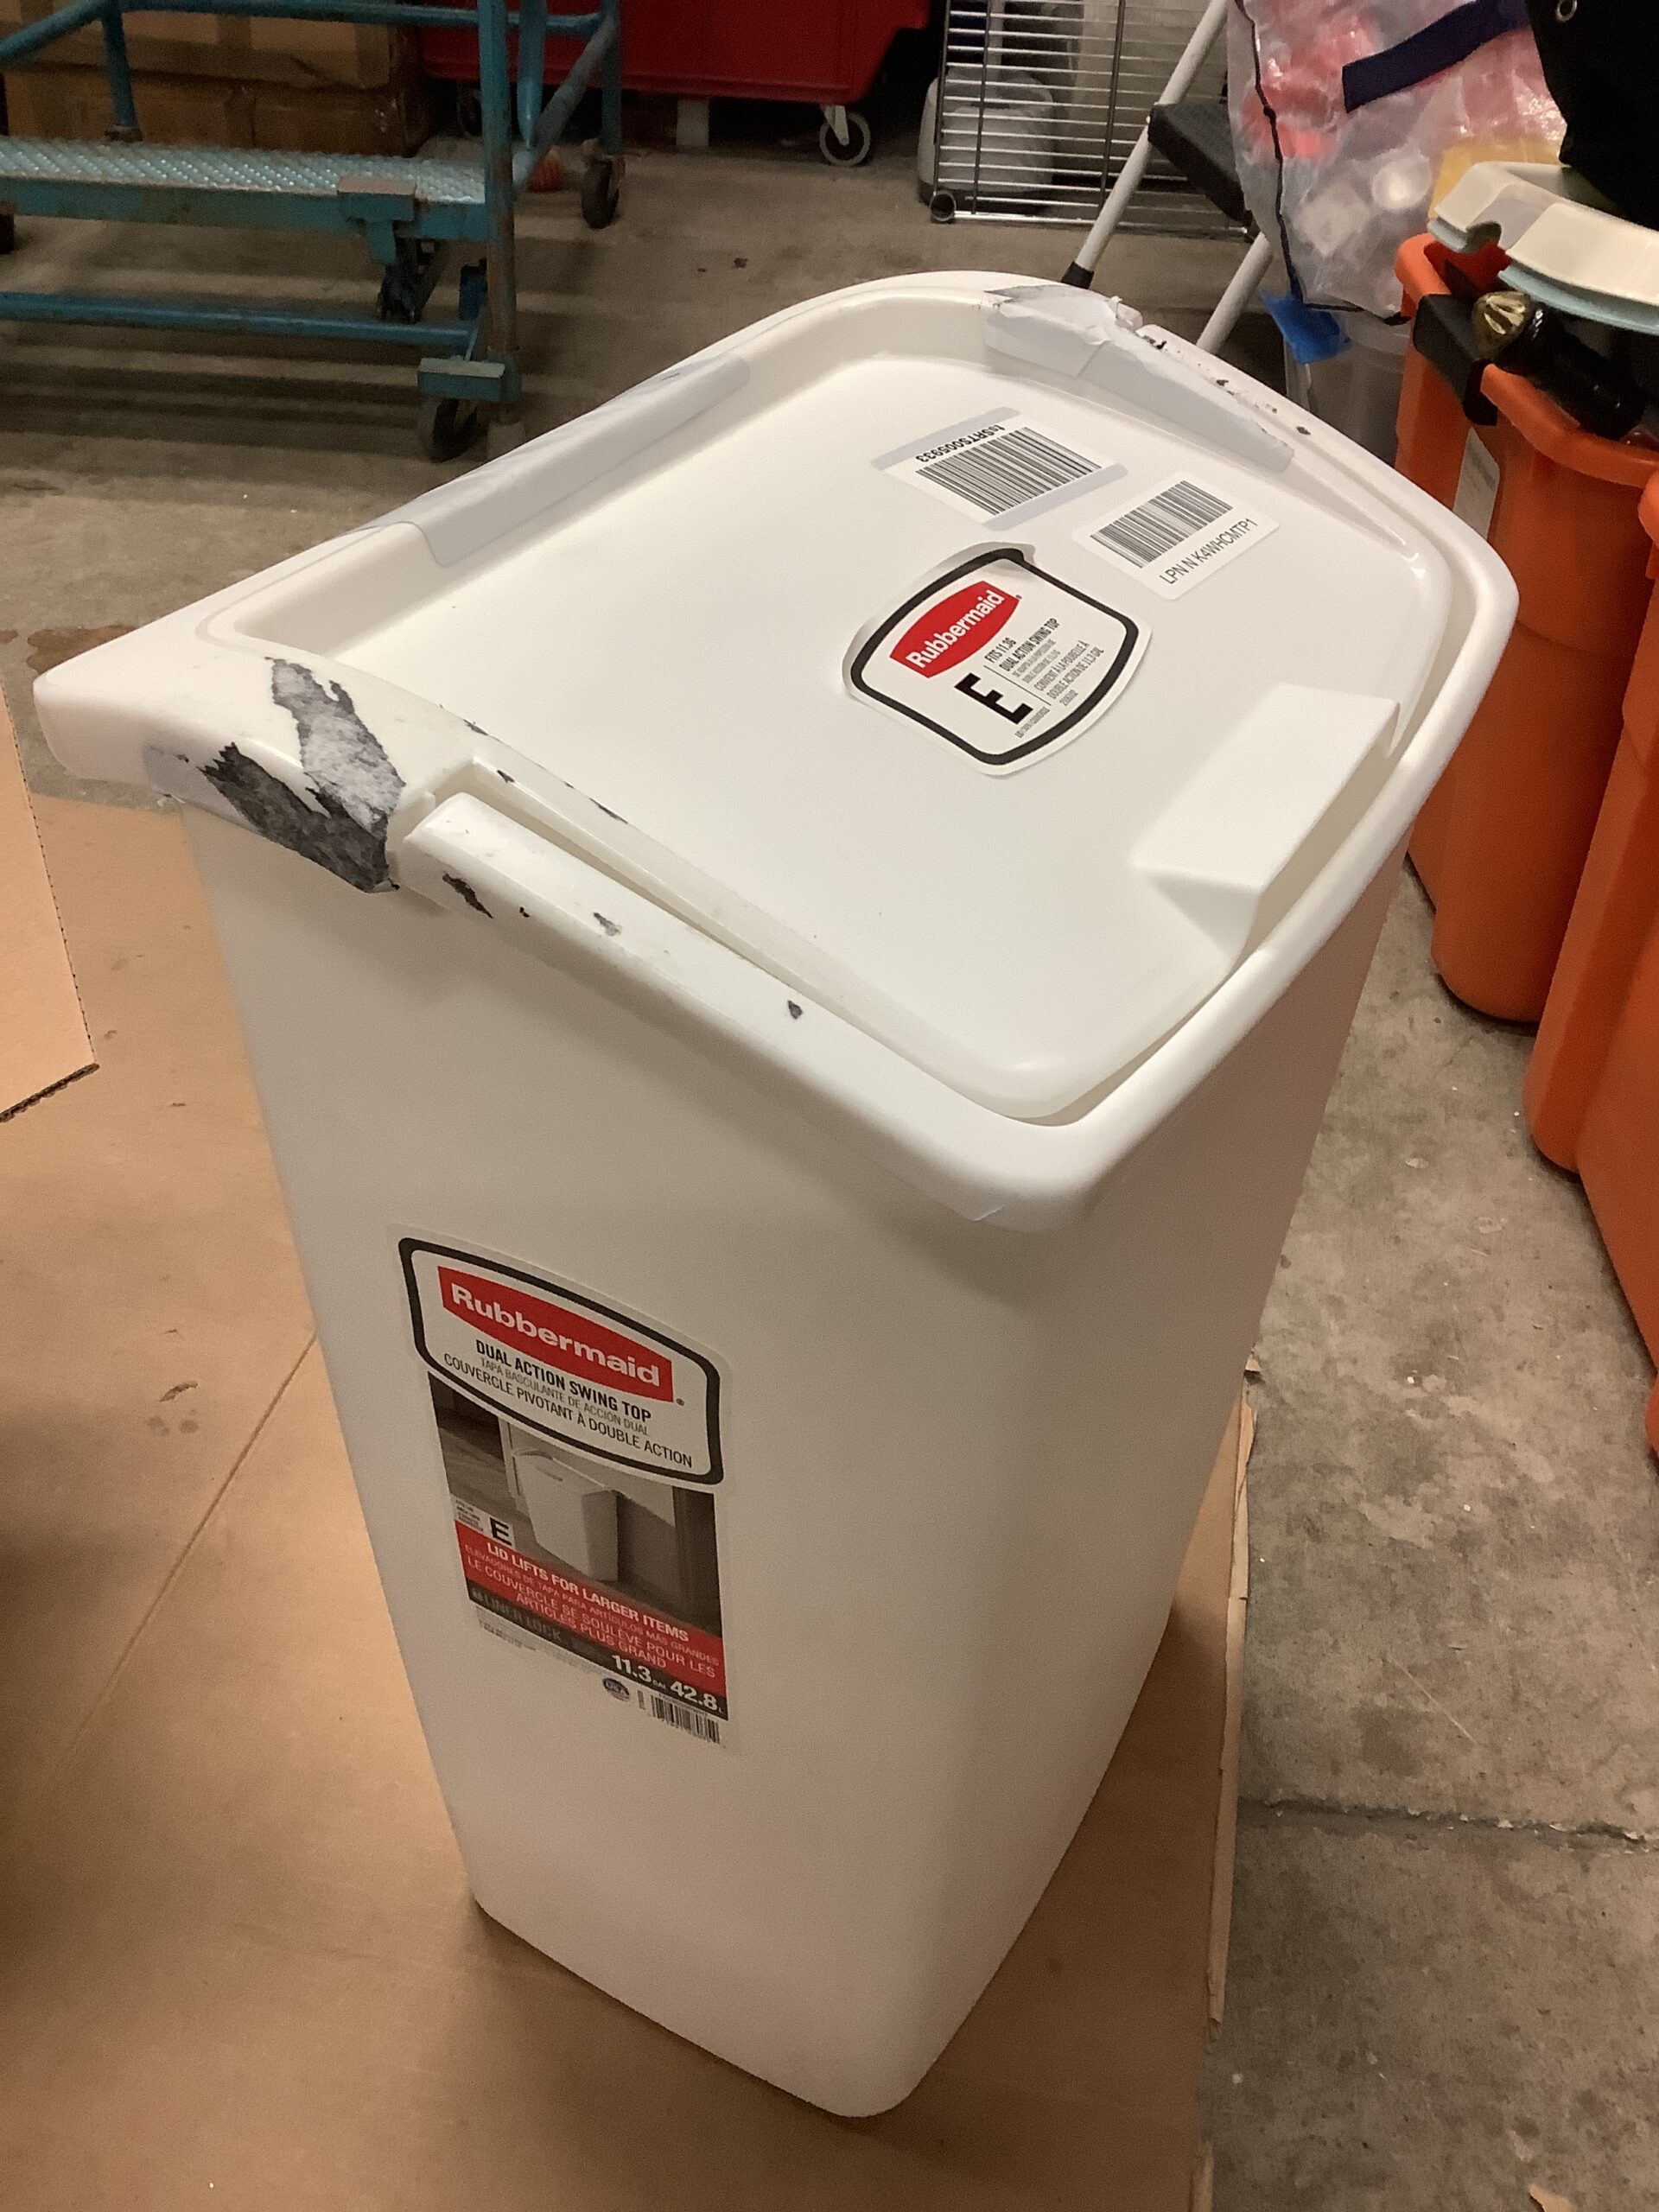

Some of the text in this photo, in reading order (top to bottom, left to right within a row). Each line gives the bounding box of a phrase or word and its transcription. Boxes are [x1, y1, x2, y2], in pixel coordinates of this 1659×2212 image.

[1159, 518, 1258, 584] LPN N K4WHCMTP1
[906, 589, 1005, 668] Rubbermaid
[984, 649, 1002, 664] FITS
[999, 657, 1020, 671] DUAL
[1012, 640, 1036, 660] ACTION
[1028, 626, 1052, 645] SWING
[1044, 617, 1060, 630] TOP
[954, 673, 1033, 724] E
[451, 1282, 660, 1387] Rubbermaid
[443, 1353, 692, 1468] COUVERCLE PIVOTANT À DOUBLE ACTION
[476, 1339, 652, 1423] DUAL ACTION SWING TOP
[480, 1357, 650, 1437] TAPA BASCULANTE DE ACCIÓN DUAL
[489, 1516, 512, 1546] E
[467, 1555, 715, 1678] LE COUVERCLE SE SOULÈVE POUR LES
[487, 1542, 690, 1642] LID LIFTS FOR LARGER ITEMS
[516, 1592, 577, 1630] ARTICLES
[580, 1623, 615, 1647] PLUS
[619, 1642, 667, 1669] GRAND
[537, 1580, 560, 1598] TAPA
[671, 1641, 719, 1667] GRANDES
[612, 1655, 652, 1683] 11.3
[670, 1681, 718, 1711] 42.8
